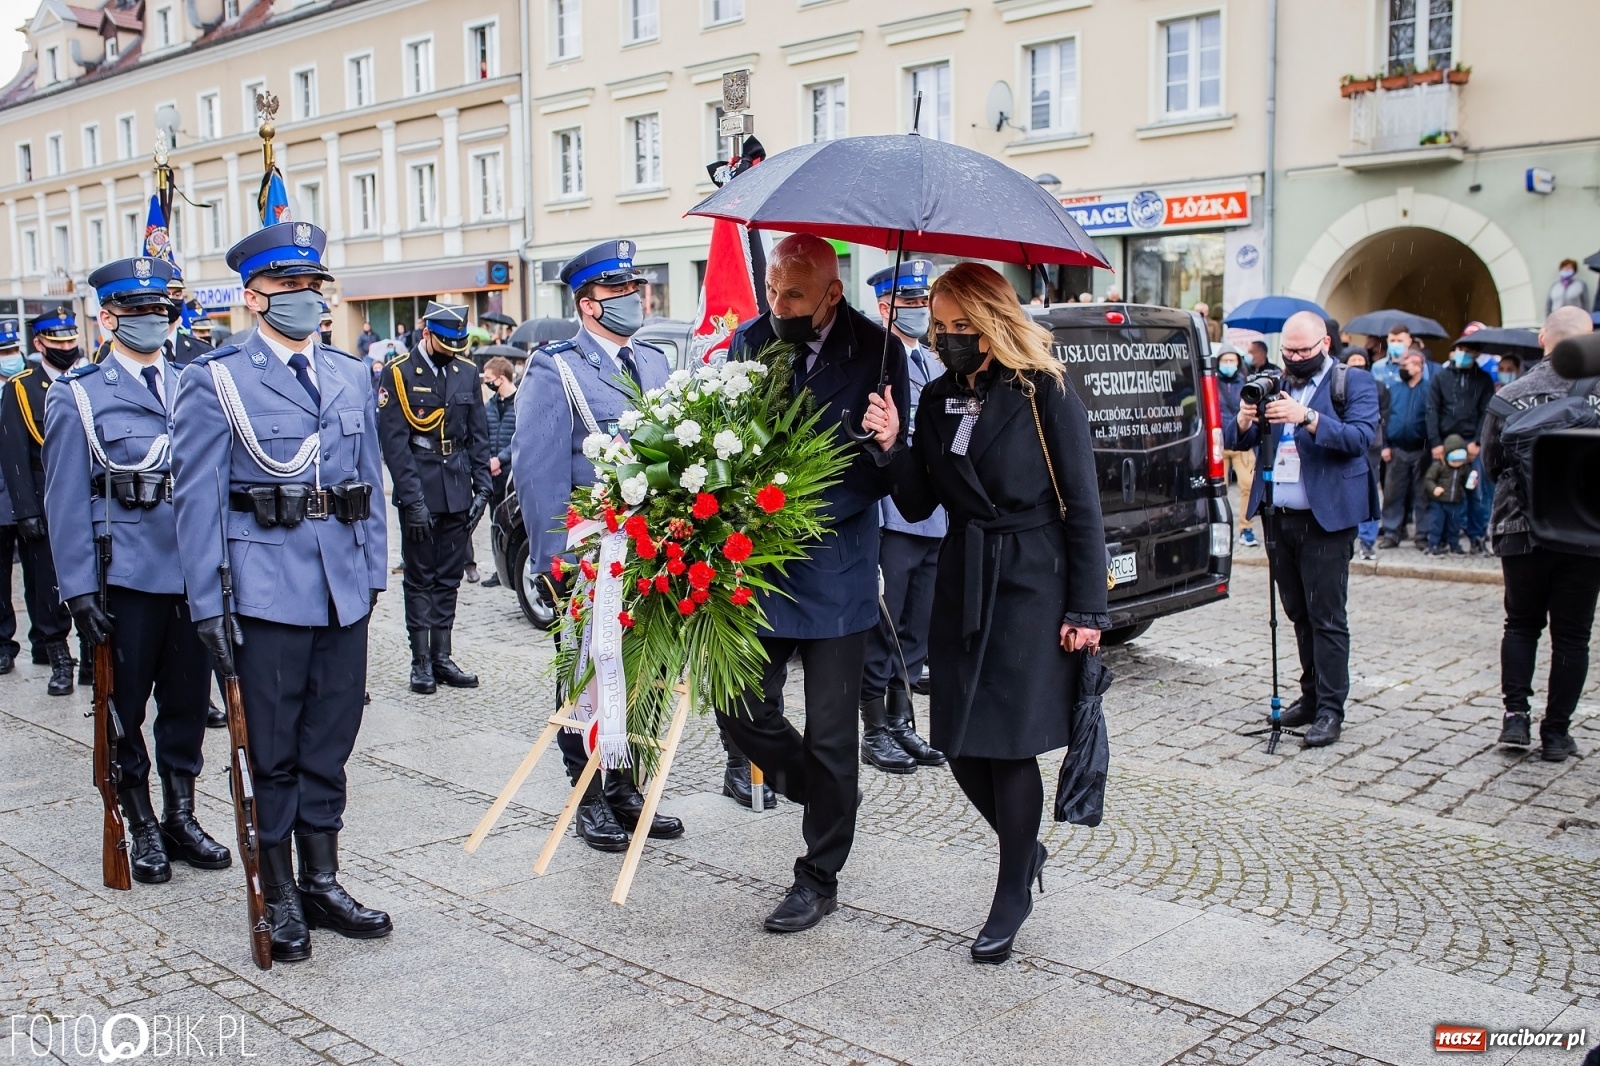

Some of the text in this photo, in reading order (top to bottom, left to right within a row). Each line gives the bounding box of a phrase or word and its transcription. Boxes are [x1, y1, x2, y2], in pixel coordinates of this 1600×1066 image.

[1171, 196, 1242, 219] ŁÓŻKA
[1056, 343, 1189, 364] USŁUGI POGRZEBOWE
[1087, 406, 1134, 422] RACIBÓRZ,
[1134, 407, 1147, 419] UL.
[1147, 406, 1174, 419] OCICKA
[1095, 425, 1107, 439] tel.
[1108, 424, 1131, 440] 32/415
[1132, 424, 1140, 436] 57
[1151, 422, 1162, 435] 602
[600, 584, 621, 666] Rejonowego
[603, 669, 621, 720] Sądu
